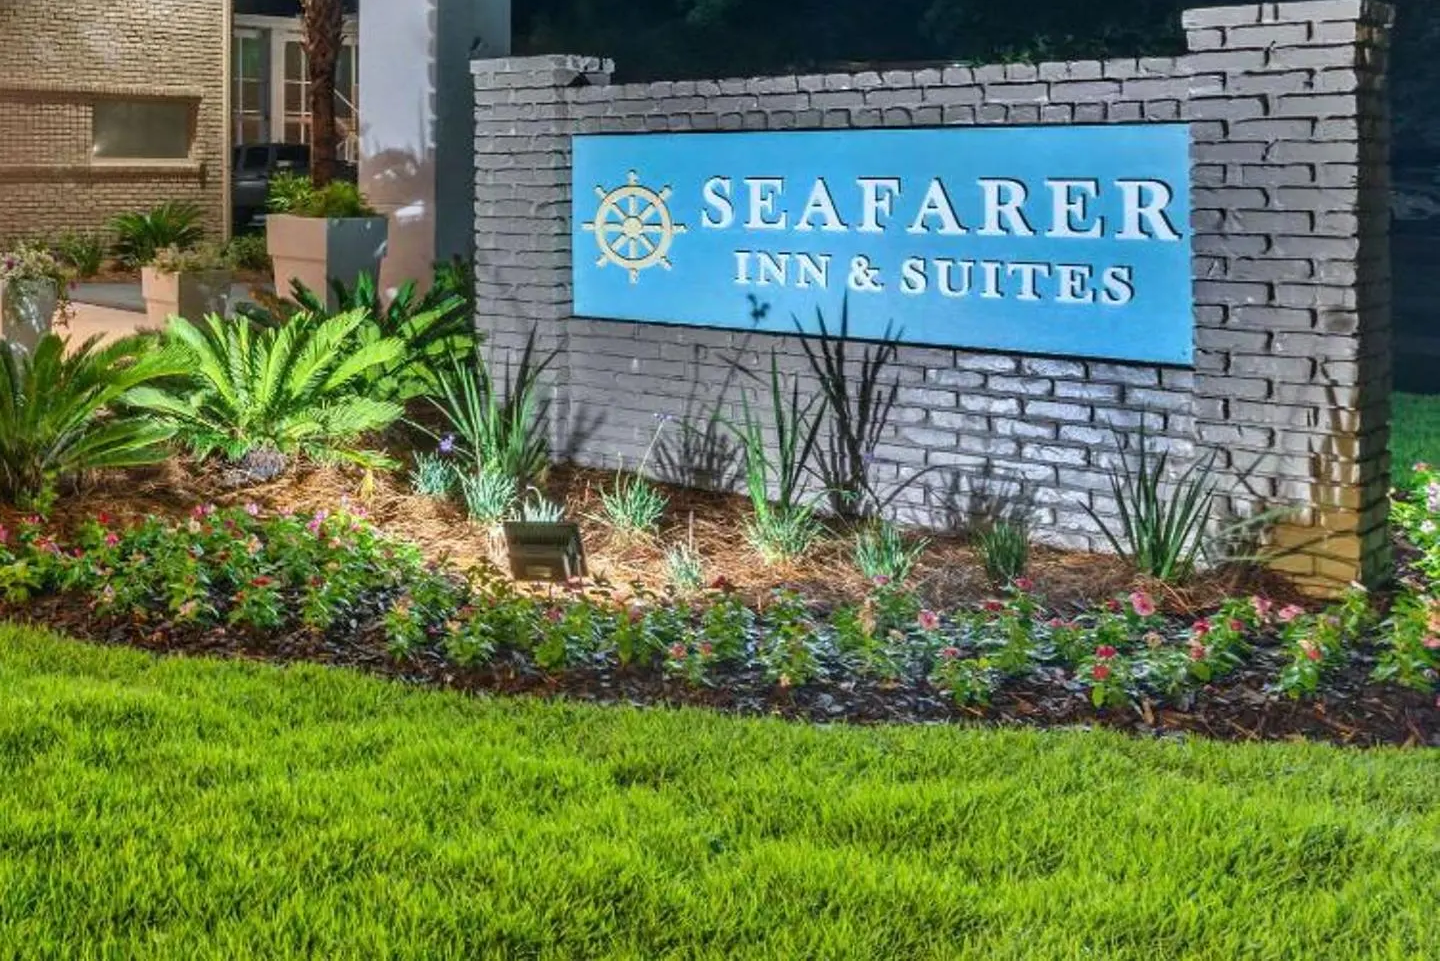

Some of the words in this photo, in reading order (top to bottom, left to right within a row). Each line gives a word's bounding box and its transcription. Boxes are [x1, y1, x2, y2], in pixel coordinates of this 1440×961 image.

[701, 176, 1182, 241] SEAFARER
[733, 250, 832, 288] INN
[848, 254, 885, 291] &
[899, 256, 1135, 305] SUITES
